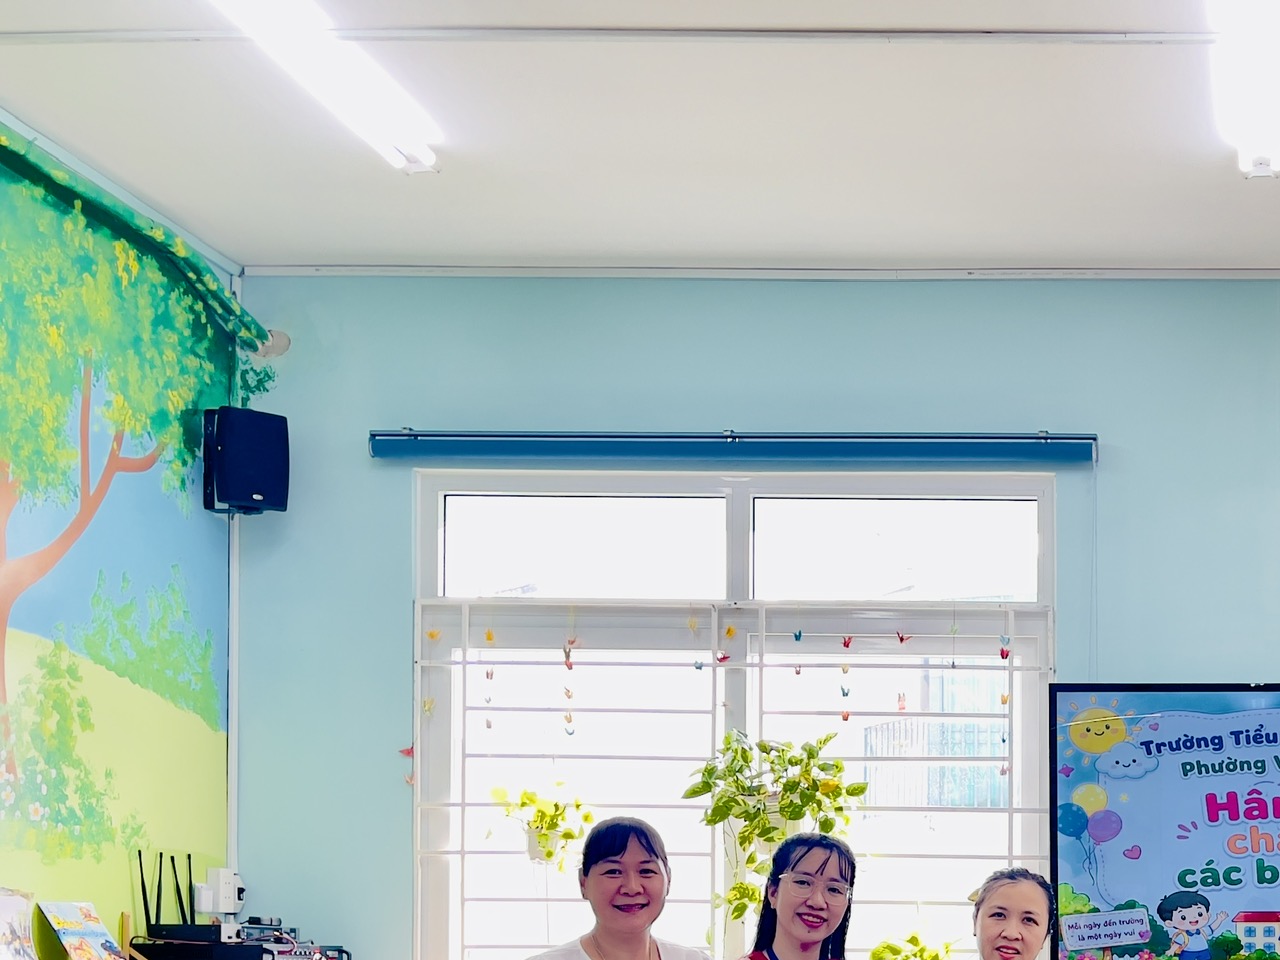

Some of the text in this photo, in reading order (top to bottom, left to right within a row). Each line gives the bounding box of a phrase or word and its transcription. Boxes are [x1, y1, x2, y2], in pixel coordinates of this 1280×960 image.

[1140, 734, 1224, 757] Trường
[1230, 724, 1279, 746] Tiểu
[1181, 757, 1266, 777] Phường
[1177, 859, 1243, 888] các
[1067, 922, 1081, 930] Mỗi
[1084, 922, 1101, 931] ngày
[1103, 919, 1117, 927] đến
[1104, 932, 1121, 940] ngày
